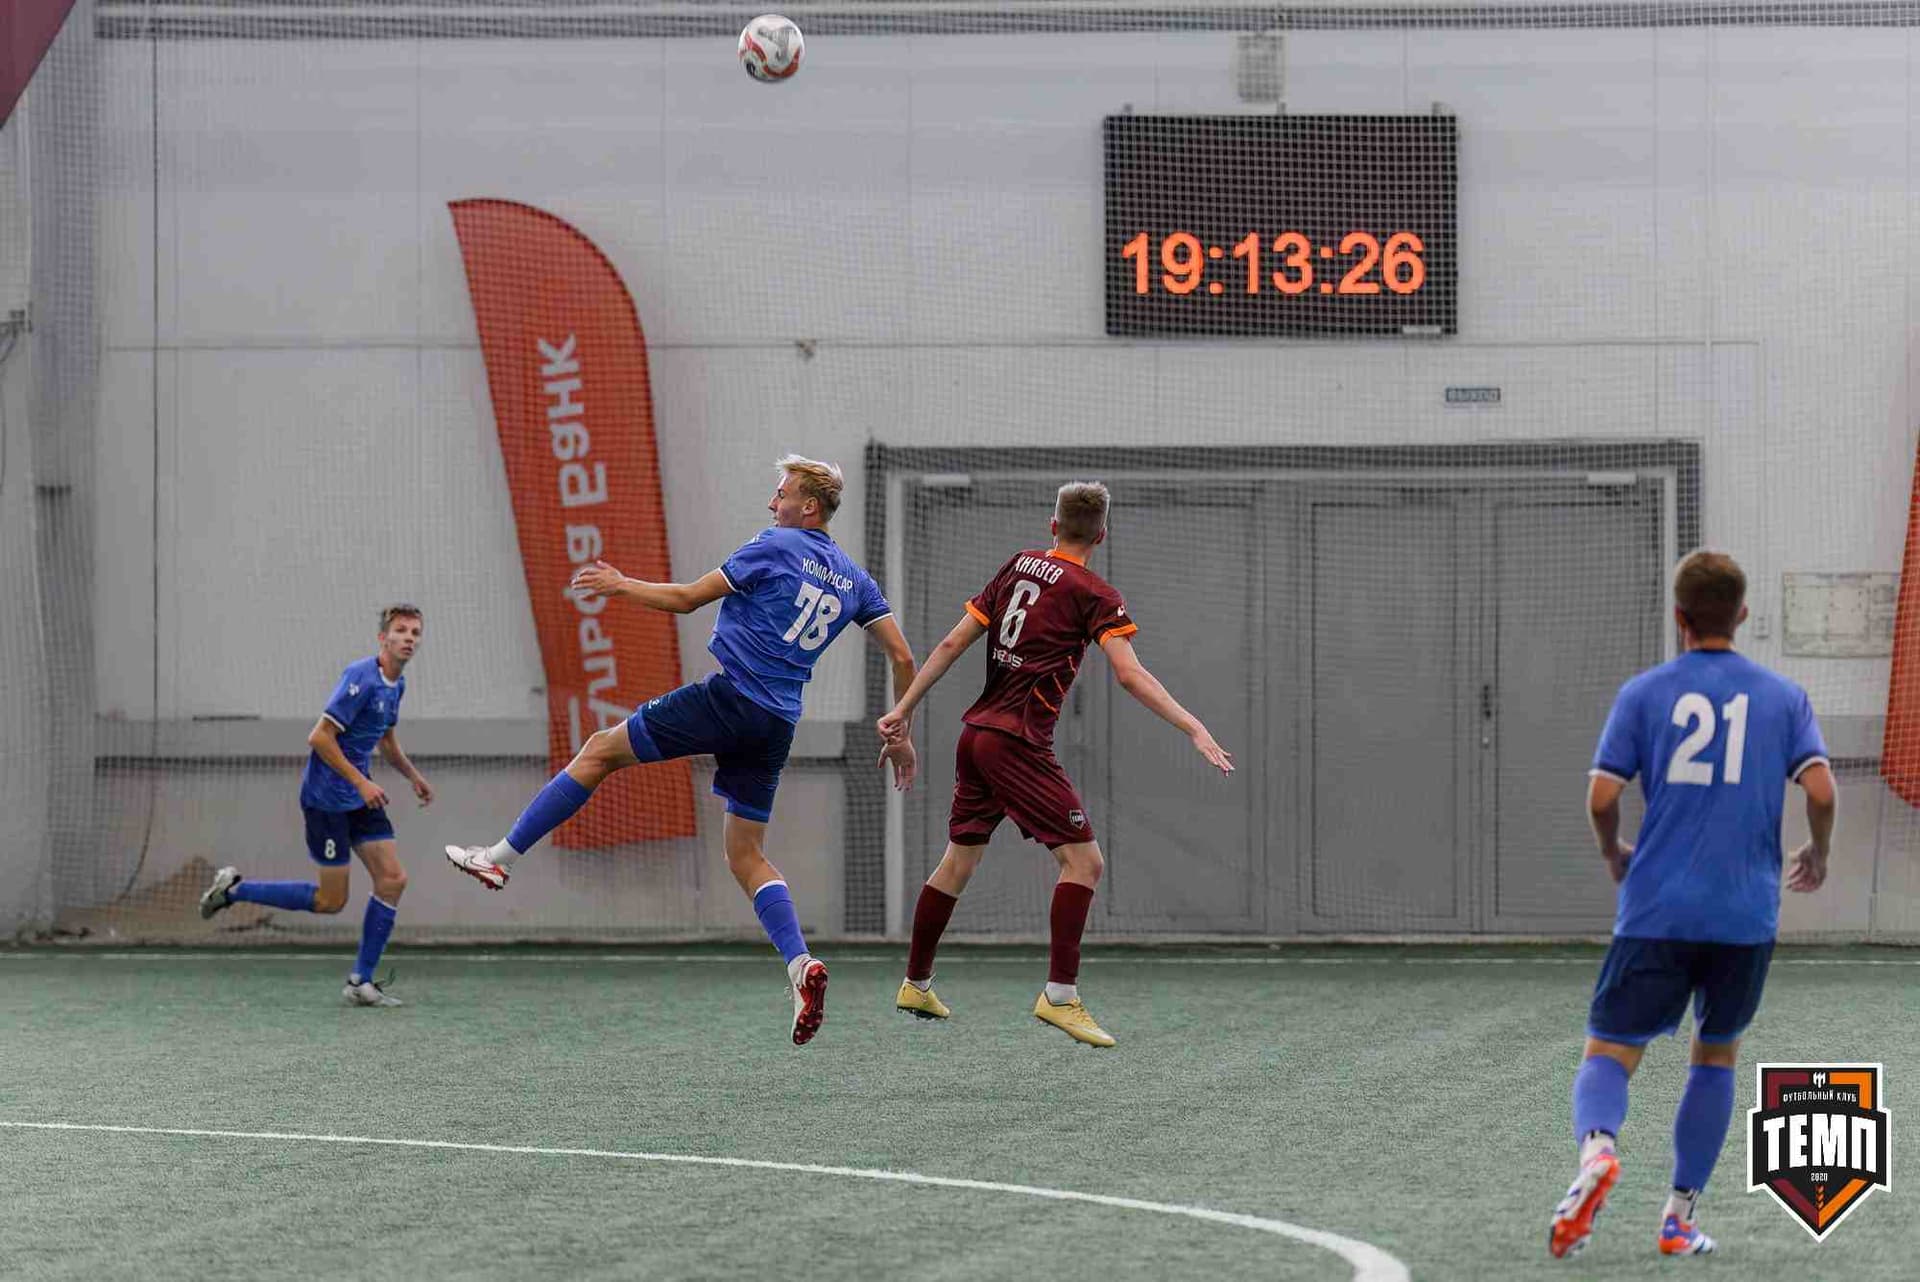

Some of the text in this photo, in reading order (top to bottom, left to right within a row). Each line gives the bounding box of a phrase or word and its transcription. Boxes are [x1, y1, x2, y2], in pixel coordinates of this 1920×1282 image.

[1122, 231, 1426, 294] 19:13:26
[782, 581, 842, 651] 78
[1000, 579, 1041, 649] 6
[1666, 692, 1749, 786] 21
[324, 838, 337, 859] 8
